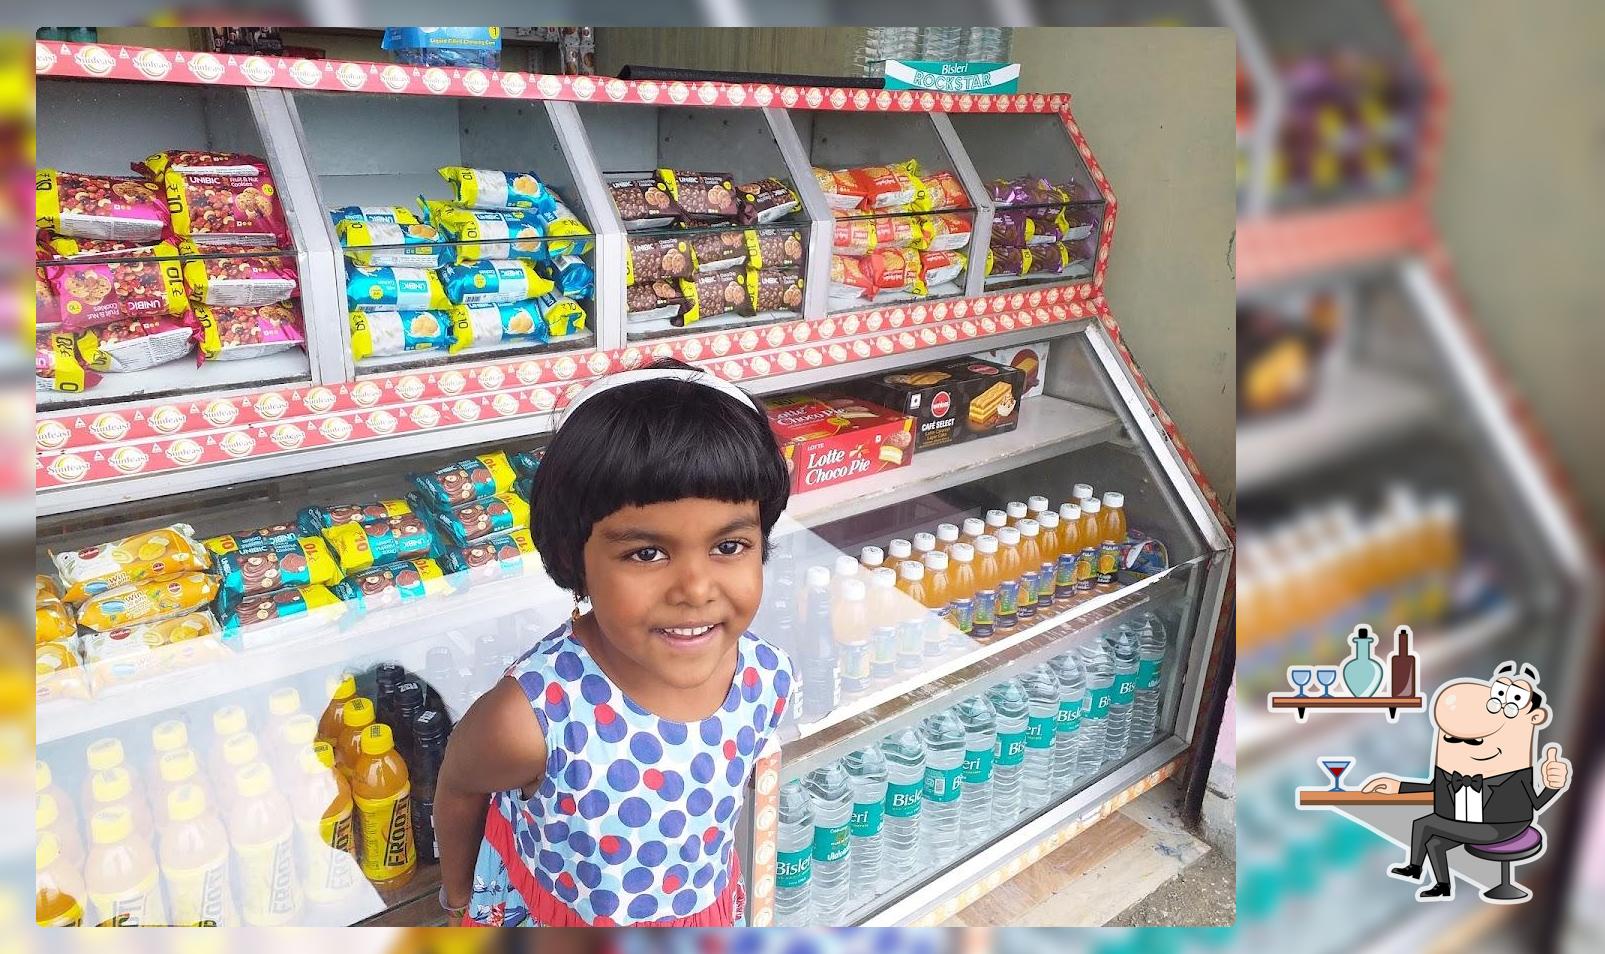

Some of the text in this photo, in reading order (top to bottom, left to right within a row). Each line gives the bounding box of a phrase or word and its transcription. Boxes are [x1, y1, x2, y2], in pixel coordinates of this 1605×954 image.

[942, 63, 968, 75] Bisleri
[914, 71, 992, 90] ROCKSTAR
[128, 300, 161, 311] UNIBIC
[254, 400, 289, 413] Sunfeast
[202, 407, 239, 420] Sunfeast
[148, 414, 186, 427] Sunfeast
[922, 418, 955, 431] CAFÉ SELECT
[89, 421, 131, 434] Sunfeast
[271, 433, 305, 444] Sunfeast
[219, 440, 255, 452] Sunfeast
[807, 443, 824, 451] LOTTE
[166, 447, 204, 459] Sunfeast
[807, 449, 845, 469] Lotte
[108, 454, 150, 467] Sunfeast
[48, 461, 91, 475] Sunfeast
[805, 459, 870, 485] Choco Pie
[269, 533, 296, 544] UNIBIC
[239, 546, 268, 555] UNIBIC
[387, 797, 409, 866] FROOTI
